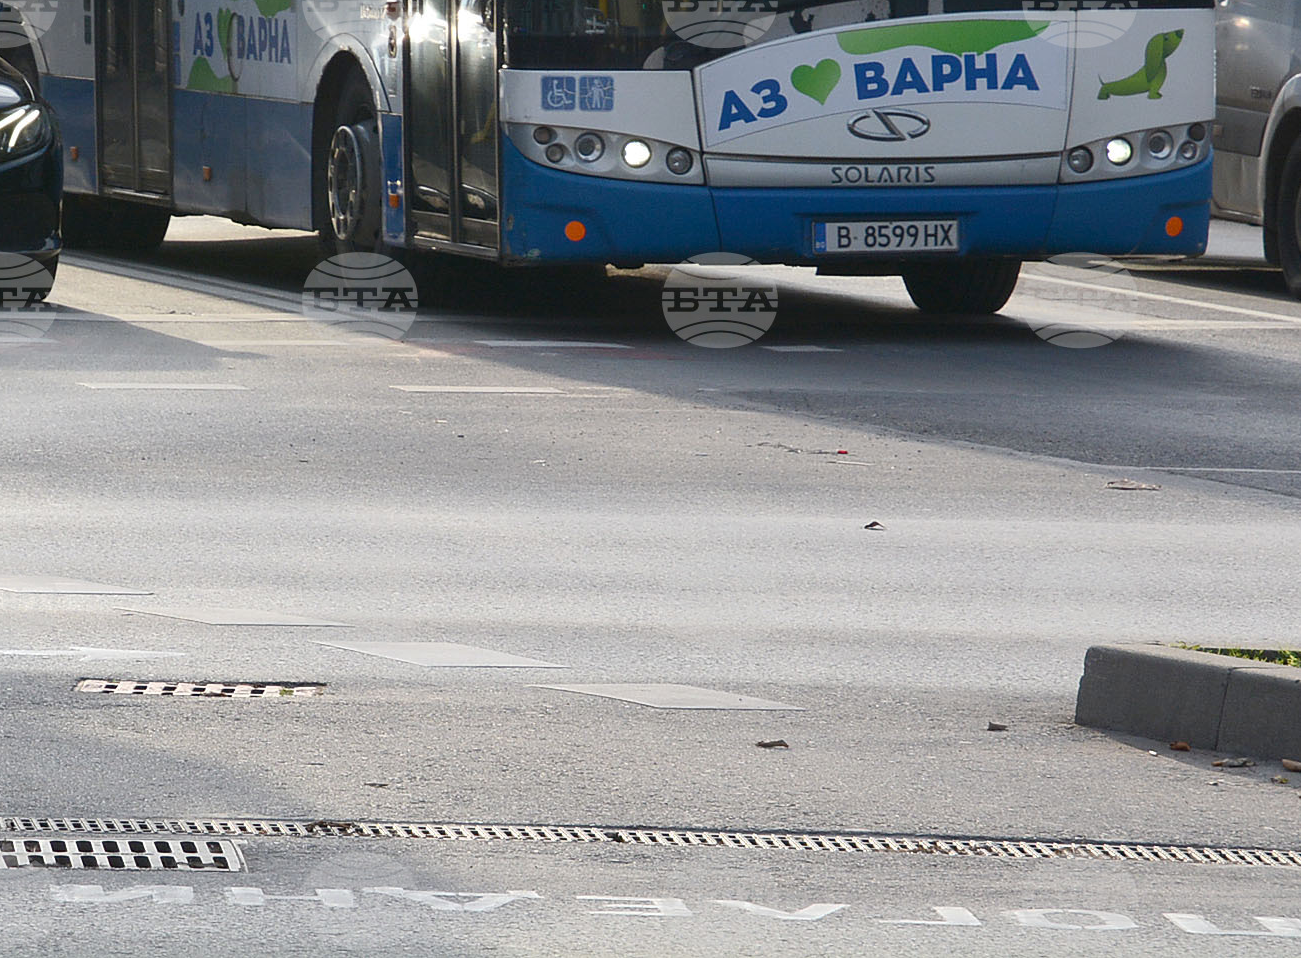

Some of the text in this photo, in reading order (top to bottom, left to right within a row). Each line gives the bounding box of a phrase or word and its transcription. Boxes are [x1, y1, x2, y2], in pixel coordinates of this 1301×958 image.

[193, 12, 292, 64] АЗ ВАРНА
[717, 52, 1041, 132] АЗ ВАРНА
[830, 166, 937, 184] SOLARIS
